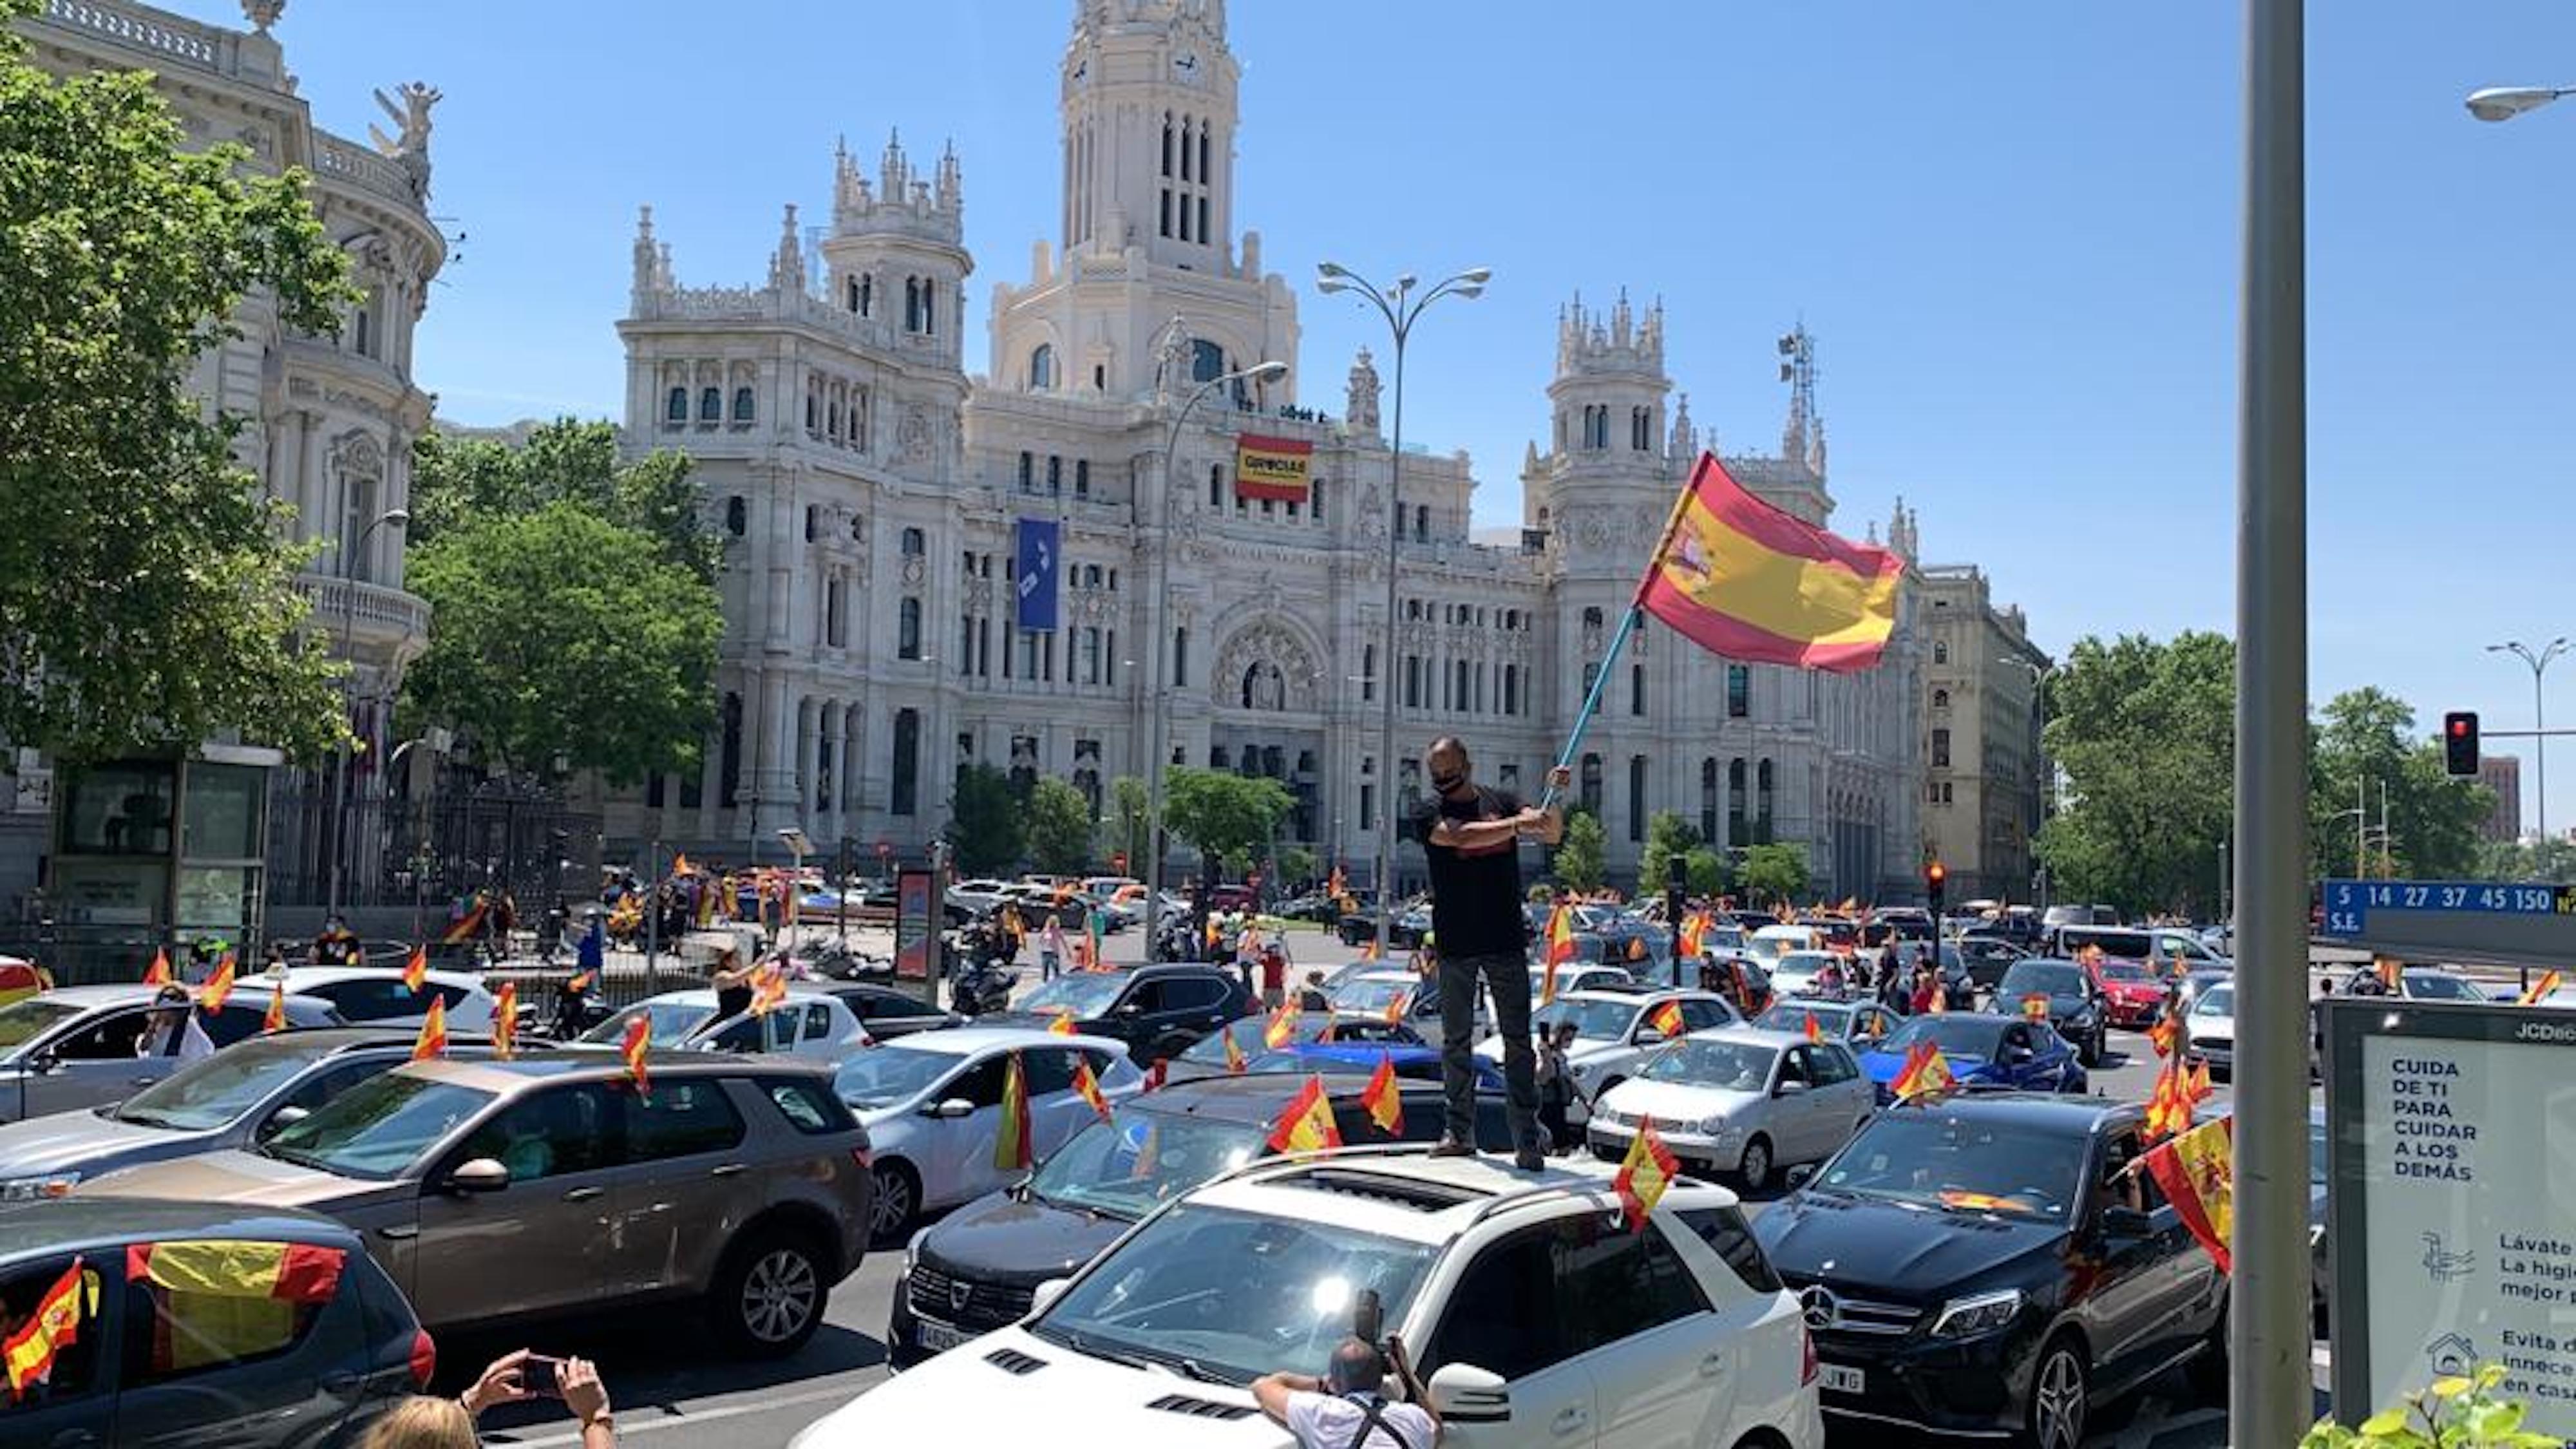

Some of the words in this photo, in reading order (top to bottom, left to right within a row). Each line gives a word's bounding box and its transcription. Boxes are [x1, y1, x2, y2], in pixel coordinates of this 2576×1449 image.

[2339, 886, 2351, 905] 5
[2369, 886, 2391, 905] 14
[2405, 887, 2429, 907] 27
[2442, 887, 2466, 907] 37
[2479, 888, 2507, 909] 45
[2515, 889, 2550, 909] 150
[2331, 913, 2359, 931] S.E.
[2392, 1059, 2459, 1077] CUIDA
[2394, 1080, 2421, 1095] DE
[2428, 1082, 2447, 1097] TI
[2394, 1100, 2452, 1117] PARA
[2395, 1121, 2476, 1140] CUIDAR
[2396, 1142, 2410, 1155] A
[2417, 1144, 2458, 1159] LOS
[2396, 1162, 2472, 1181] DEMÁS
[2501, 1233, 2571, 1255] Lávate
[2501, 1257, 2525, 1273] La
[2503, 1283, 2563, 1300] mejor
[2503, 1331, 2555, 1350] Evita
[2505, 1379, 2528, 1392] en
